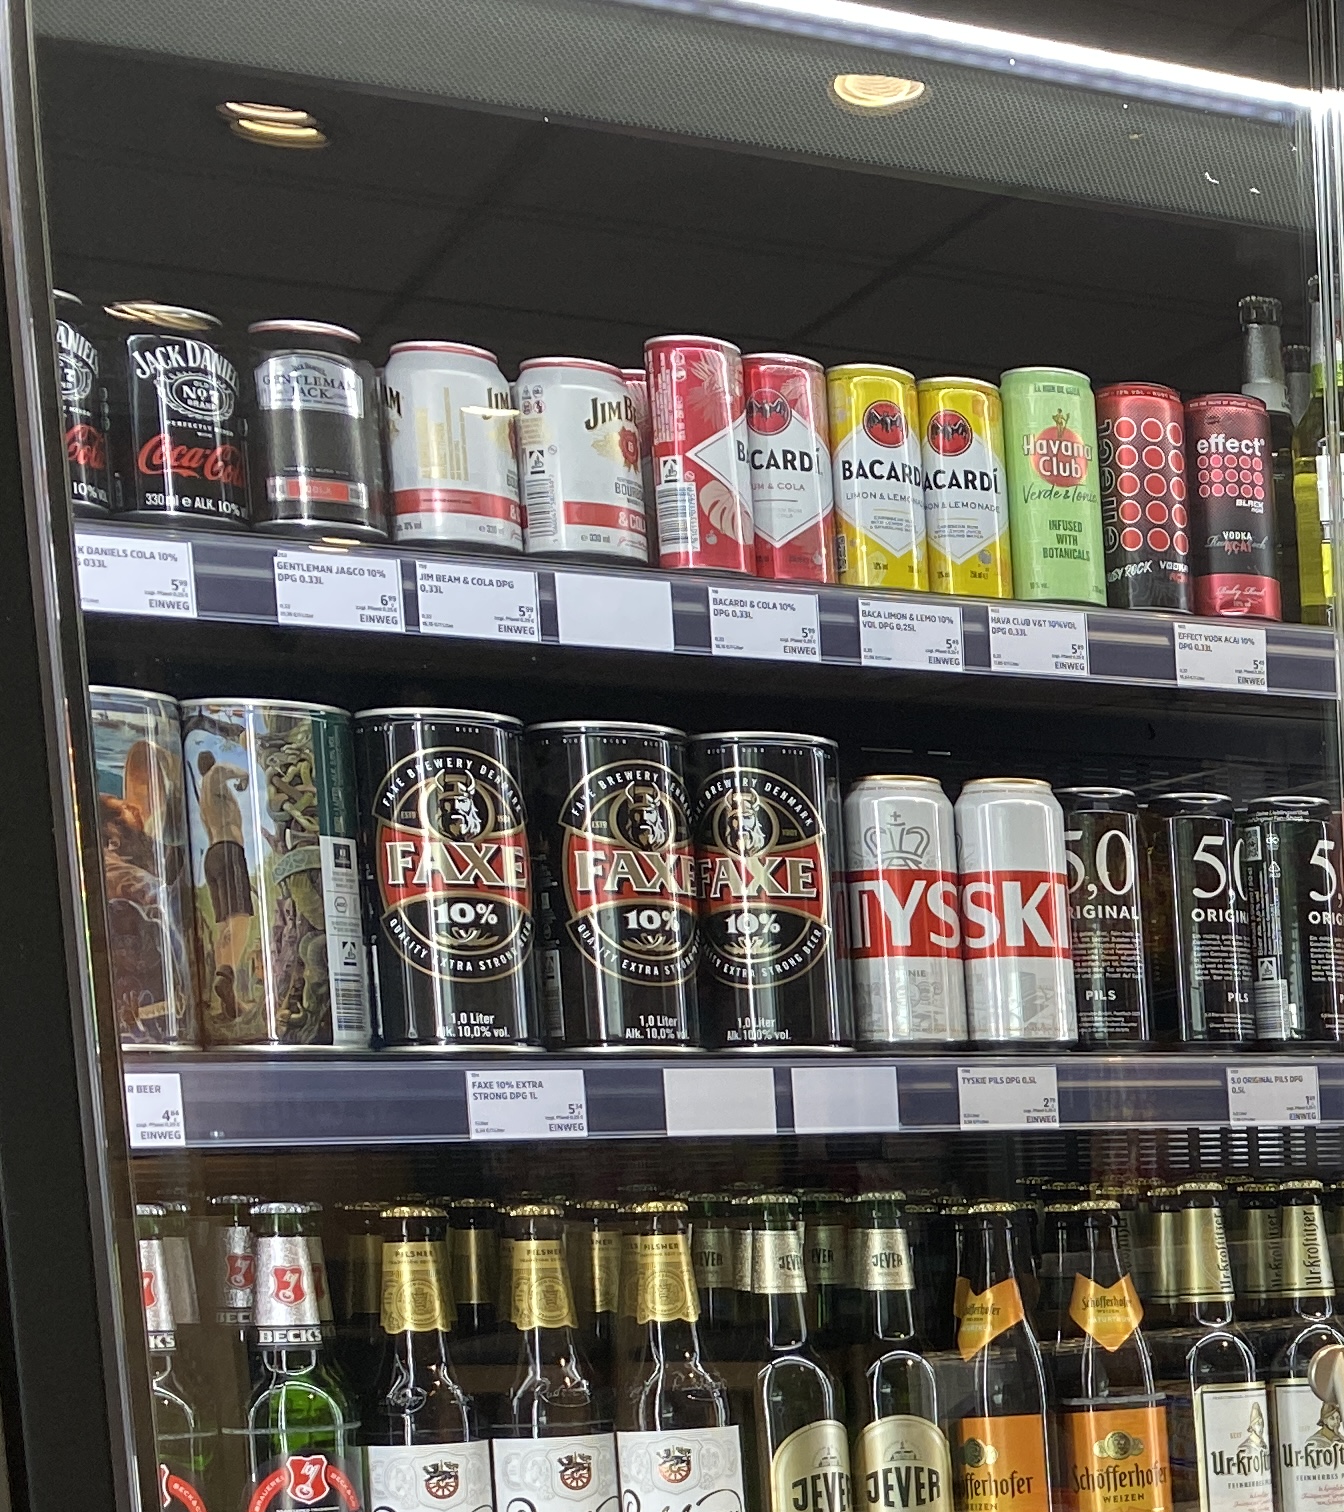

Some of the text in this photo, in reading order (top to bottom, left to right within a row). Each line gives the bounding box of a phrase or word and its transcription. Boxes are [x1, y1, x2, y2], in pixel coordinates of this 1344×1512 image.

[132, 344, 183, 380] JACK
[585, 396, 622, 431] JIM
[1022, 434, 1093, 461] Havana
[1039, 454, 1082, 478] Club
[1048, 519, 1083, 533] INFUSED
[1056, 533, 1079, 546] WITH
[1222, 532, 1252, 541] VODKA
[87, 547, 178, 563] DANIELS COLA 10%
[1042, 549, 1090, 562] BOTANICALS
[277, 561, 386, 579] GENTLEMAN JA&CO 10%
[277, 573, 298, 584] DPG
[419, 573, 515, 589] JIM BEAM COLA DPG
[148, 599, 190, 611] EINWEG
[712, 597, 796, 613] BACARDI COLA 10%
[713, 608, 730, 618] DPG
[882, 611, 907, 622] LIMON
[917, 615, 936, 625] LEMO
[938, 616, 954, 626] 10%
[359, 614, 398, 626] EINWEG
[862, 621, 894, 632] VOL DPG
[497, 624, 535, 636] EINWEG
[782, 645, 817, 657] EINWEG
[927, 655, 961, 667] EINWEG
[1054, 661, 1085, 672] EINWEG
[384, 841, 528, 889] FAXE
[576, 849, 697, 897] FAXE
[433, 902, 499, 926] 10%
[624, 910, 681, 933] 10%
[725, 912, 780, 936] 10%
[1085, 989, 1116, 1002] PILS
[450, 1012, 495, 1027] 1,0 Liter
[656, 1014, 679, 1028] Liter
[458, 1025, 511, 1040] 10,0% vol.
[646, 1027, 674, 1040] 10,0%
[471, 1080, 543, 1090] FAXE 10% EXTRA
[962, 1076, 1021, 1086] TYSKIE PILS DPG
[136, 1085, 161, 1095] BEER
[473, 1092, 527, 1102] STRONG DPG
[1026, 1115, 1057, 1124] EINWEG
[548, 1121, 586, 1133] EINWEG
[140, 1129, 181, 1141] EINWEG
[258, 1327, 323, 1344] BECK'S
[1073, 1463, 1169, 1495] Schöfferhofer
[866, 1466, 942, 1510] JEVER
[1103, 1493, 1146, 1504] WEIZEN
